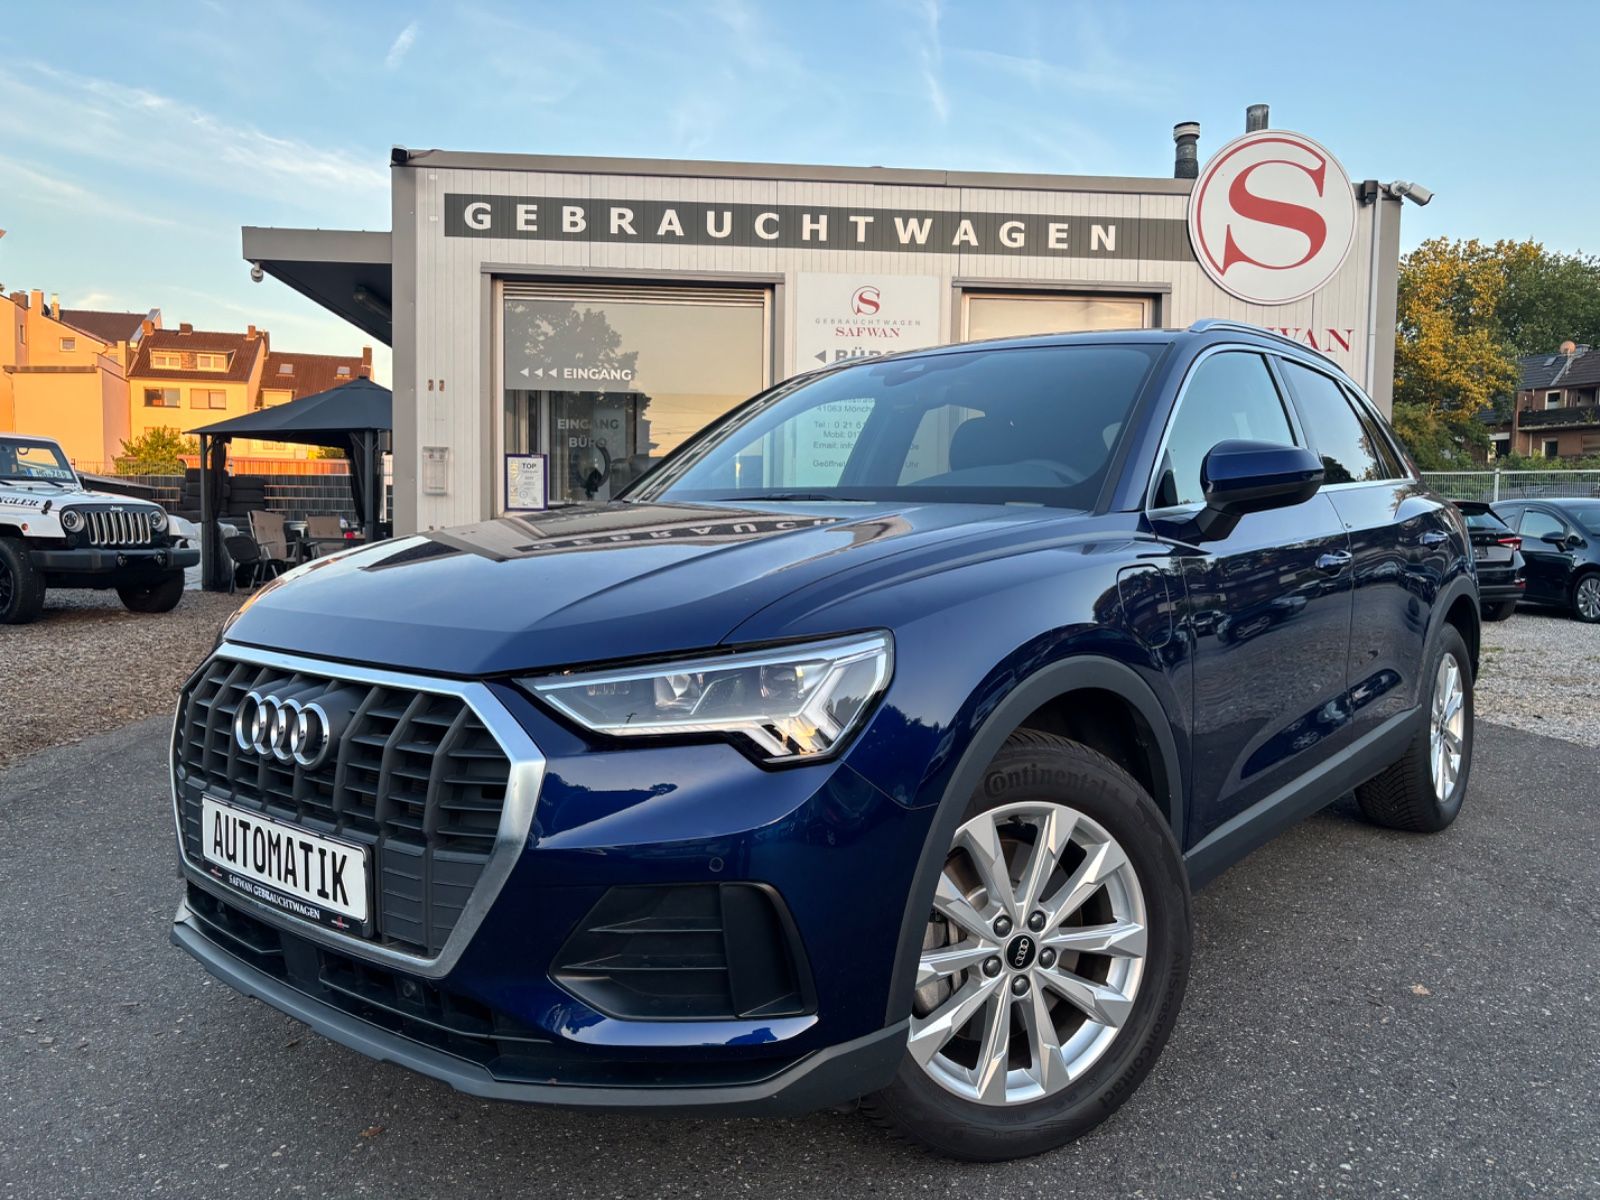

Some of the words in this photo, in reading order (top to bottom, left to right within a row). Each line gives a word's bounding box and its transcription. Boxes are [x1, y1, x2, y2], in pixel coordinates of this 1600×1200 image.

[463, 201, 1118, 252] GEBRAUCHTWAGEN
[815, 318, 921, 326] GEBRAUCHTWAGEN
[835, 326, 900, 338] SAFWAN
[563, 367, 632, 381] EINGANG
[557, 418, 620, 431] EINGANG
[568, 434, 608, 448] BÜRO
[984, 763, 1109, 798] Continental
[214, 811, 348, 905] AUTOMATIK
[228, 873, 253, 893] SAFWAN
[252, 884, 320, 920] GEBRAUCHTWAGEN
